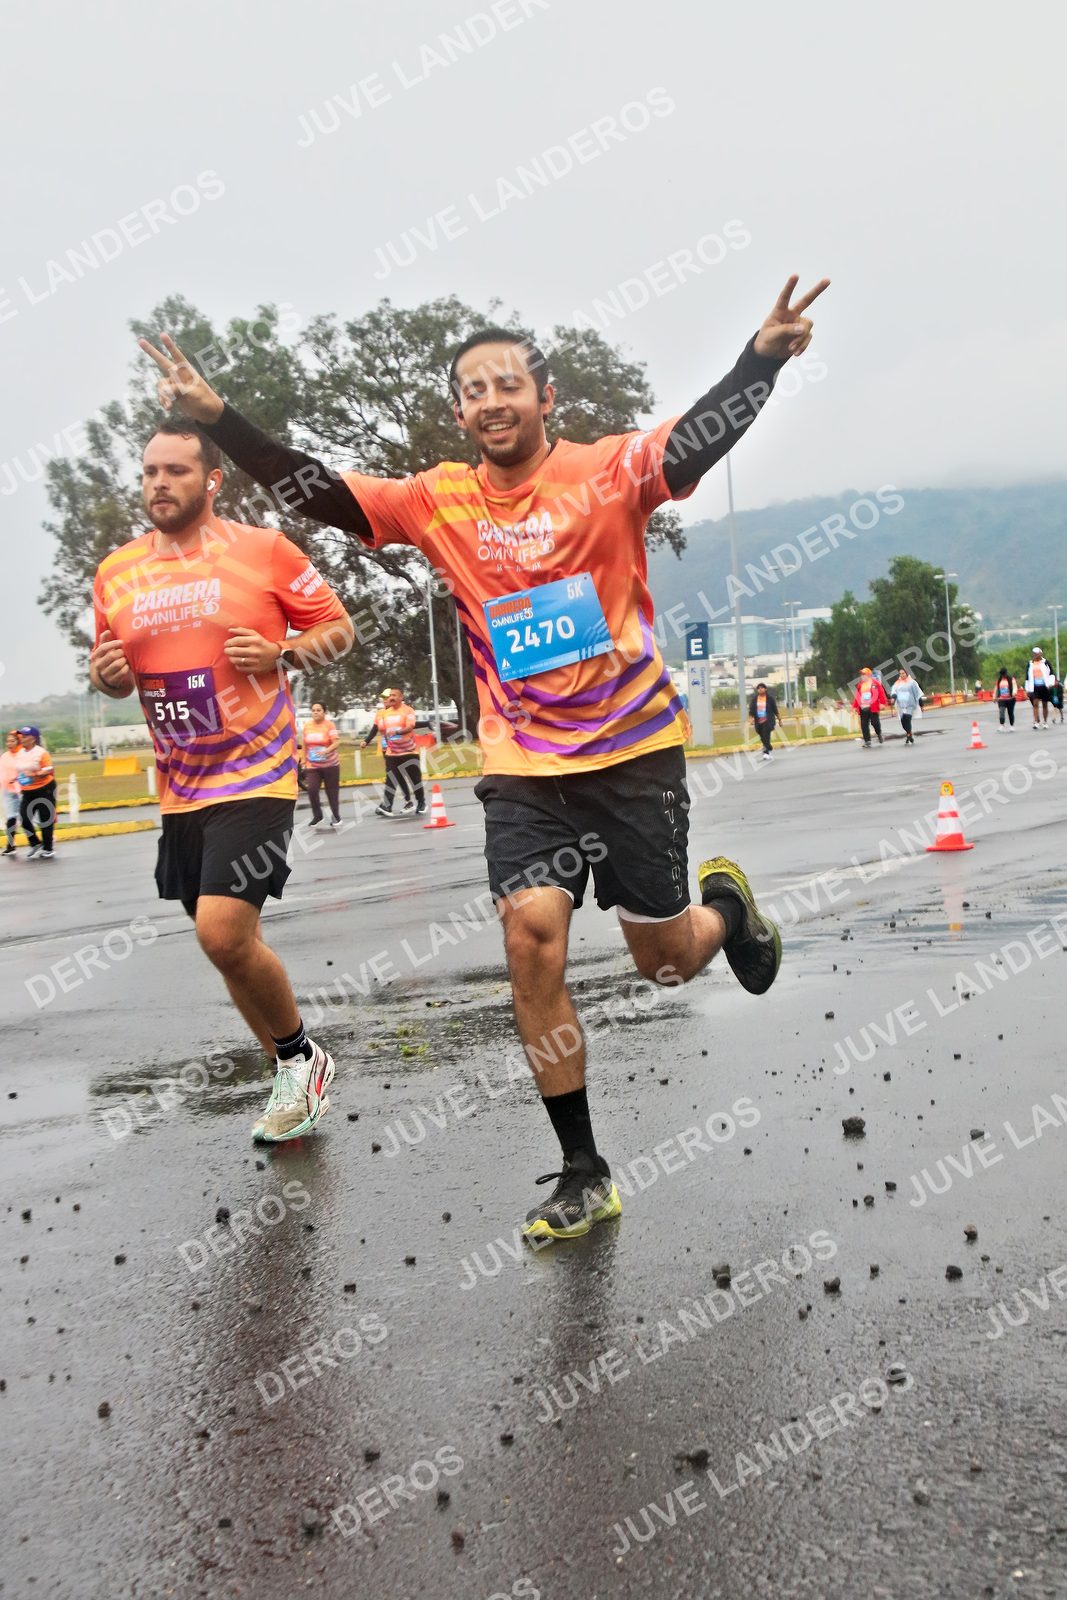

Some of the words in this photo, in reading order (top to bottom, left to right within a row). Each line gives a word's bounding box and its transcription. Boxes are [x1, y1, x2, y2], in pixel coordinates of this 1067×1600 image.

[132, 578, 221, 614] CARRERA
[506, 615, 576, 654] 2470
[690, 638, 704, 656] E
[187, 674, 206, 690] 15K
[154, 701, 190, 721] 515
